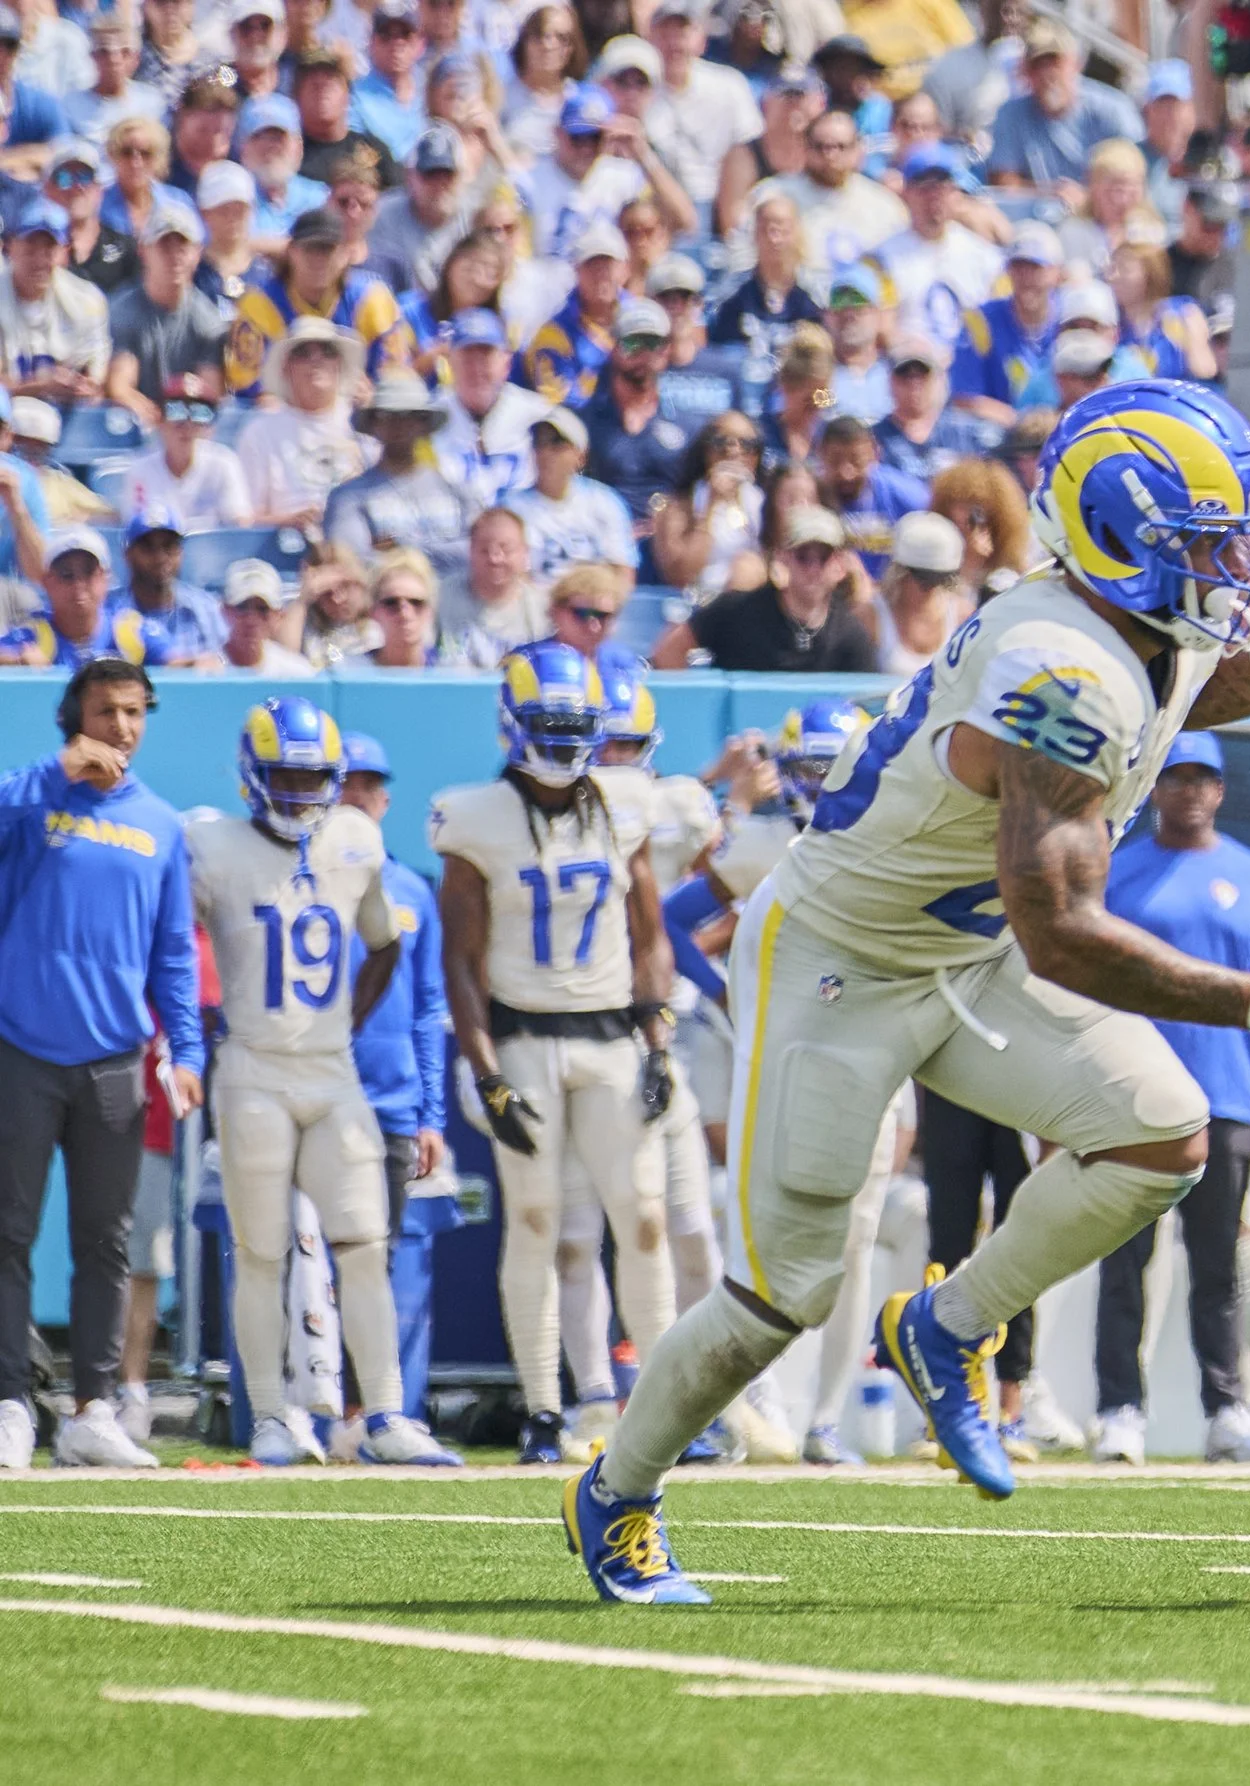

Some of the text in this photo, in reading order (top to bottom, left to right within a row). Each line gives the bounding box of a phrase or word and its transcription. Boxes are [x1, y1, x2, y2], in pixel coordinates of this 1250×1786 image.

[992, 691, 1107, 765] 23
[253, 904, 342, 1009] 19
[518, 860, 611, 967] 17
